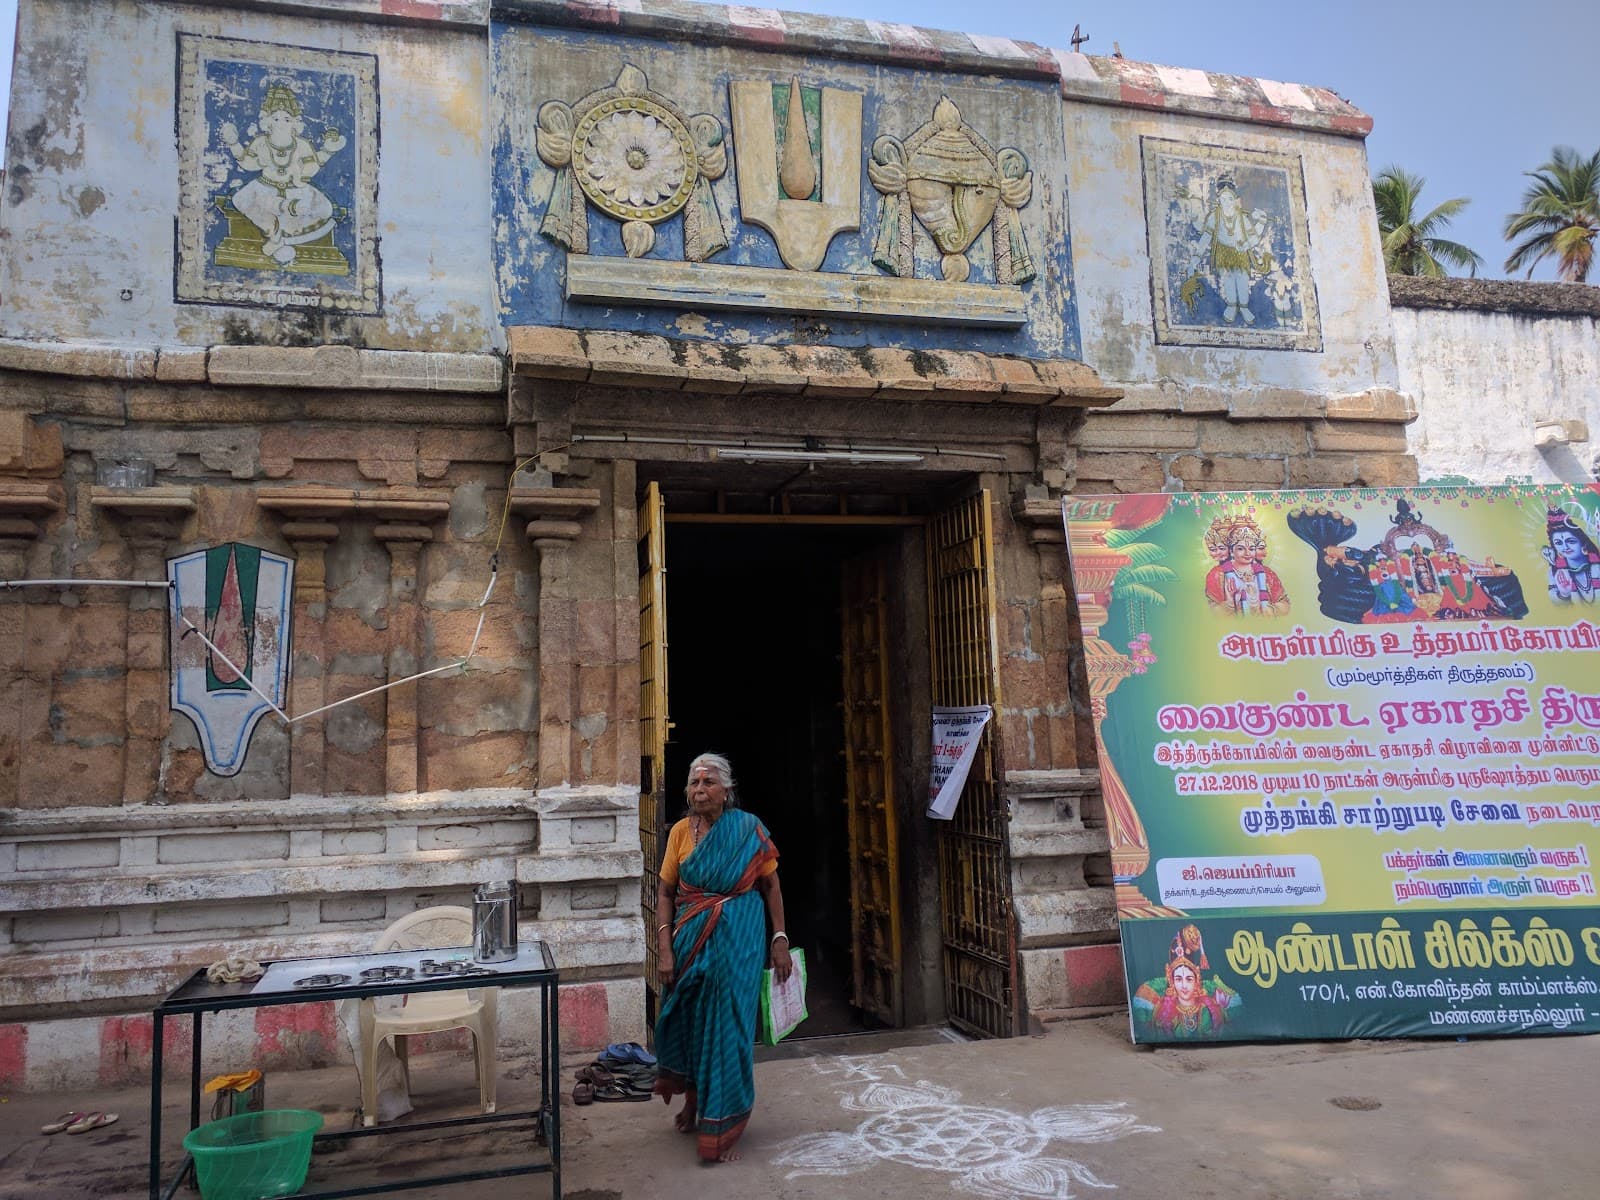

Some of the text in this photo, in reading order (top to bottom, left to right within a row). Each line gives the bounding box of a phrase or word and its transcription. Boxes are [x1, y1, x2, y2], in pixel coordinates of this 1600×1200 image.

[1222, 621, 1600, 662] அருள்மிகு உத்தமர்கோயி
[1327, 663, 1534, 687] (மும்மூர்த்திகள் திருத்தலம்)
[1159, 691, 1370, 737] வைகுண்ட
[1379, 688, 1531, 734] ஏகாதசி
[1157, 733, 1600, 765] இத்திருக்கோயிலின் வைகுண்ட ஏகாதசி விழாவினை முன்னிட்டு
[1178, 774, 1259, 793] 27.12.2018
[1262, 774, 1301, 794] முடிய
[1302, 772, 1321, 788] 10
[1323, 769, 1379, 791] நாட்கள்
[1382, 767, 1455, 791] அருள்மிகு
[1457, 764, 1551, 788] புருஷோத்தம
[1244, 799, 1338, 833] முத்தங்கி
[1343, 798, 1446, 831] சாற்றுபடி
[1450, 799, 1521, 822] சேவை
[1181, 863, 1297, 881] ஜி.ஜெயப்பிரியா
[1385, 849, 1450, 873] பக்தர்கள்
[1394, 877, 1484, 901] நம்பெருமாள்
[1487, 876, 1532, 897] அருள்
[1225, 916, 1416, 989] ஆண்டாள்
[1424, 916, 1575, 969] சில்க்ஸ்
[1299, 983, 1350, 1004] 170/1,
[1355, 976, 1492, 1004] என்.கோவிந்தன்
[1429, 1003, 1585, 1029] மண்ணச்சநல்லூர்
